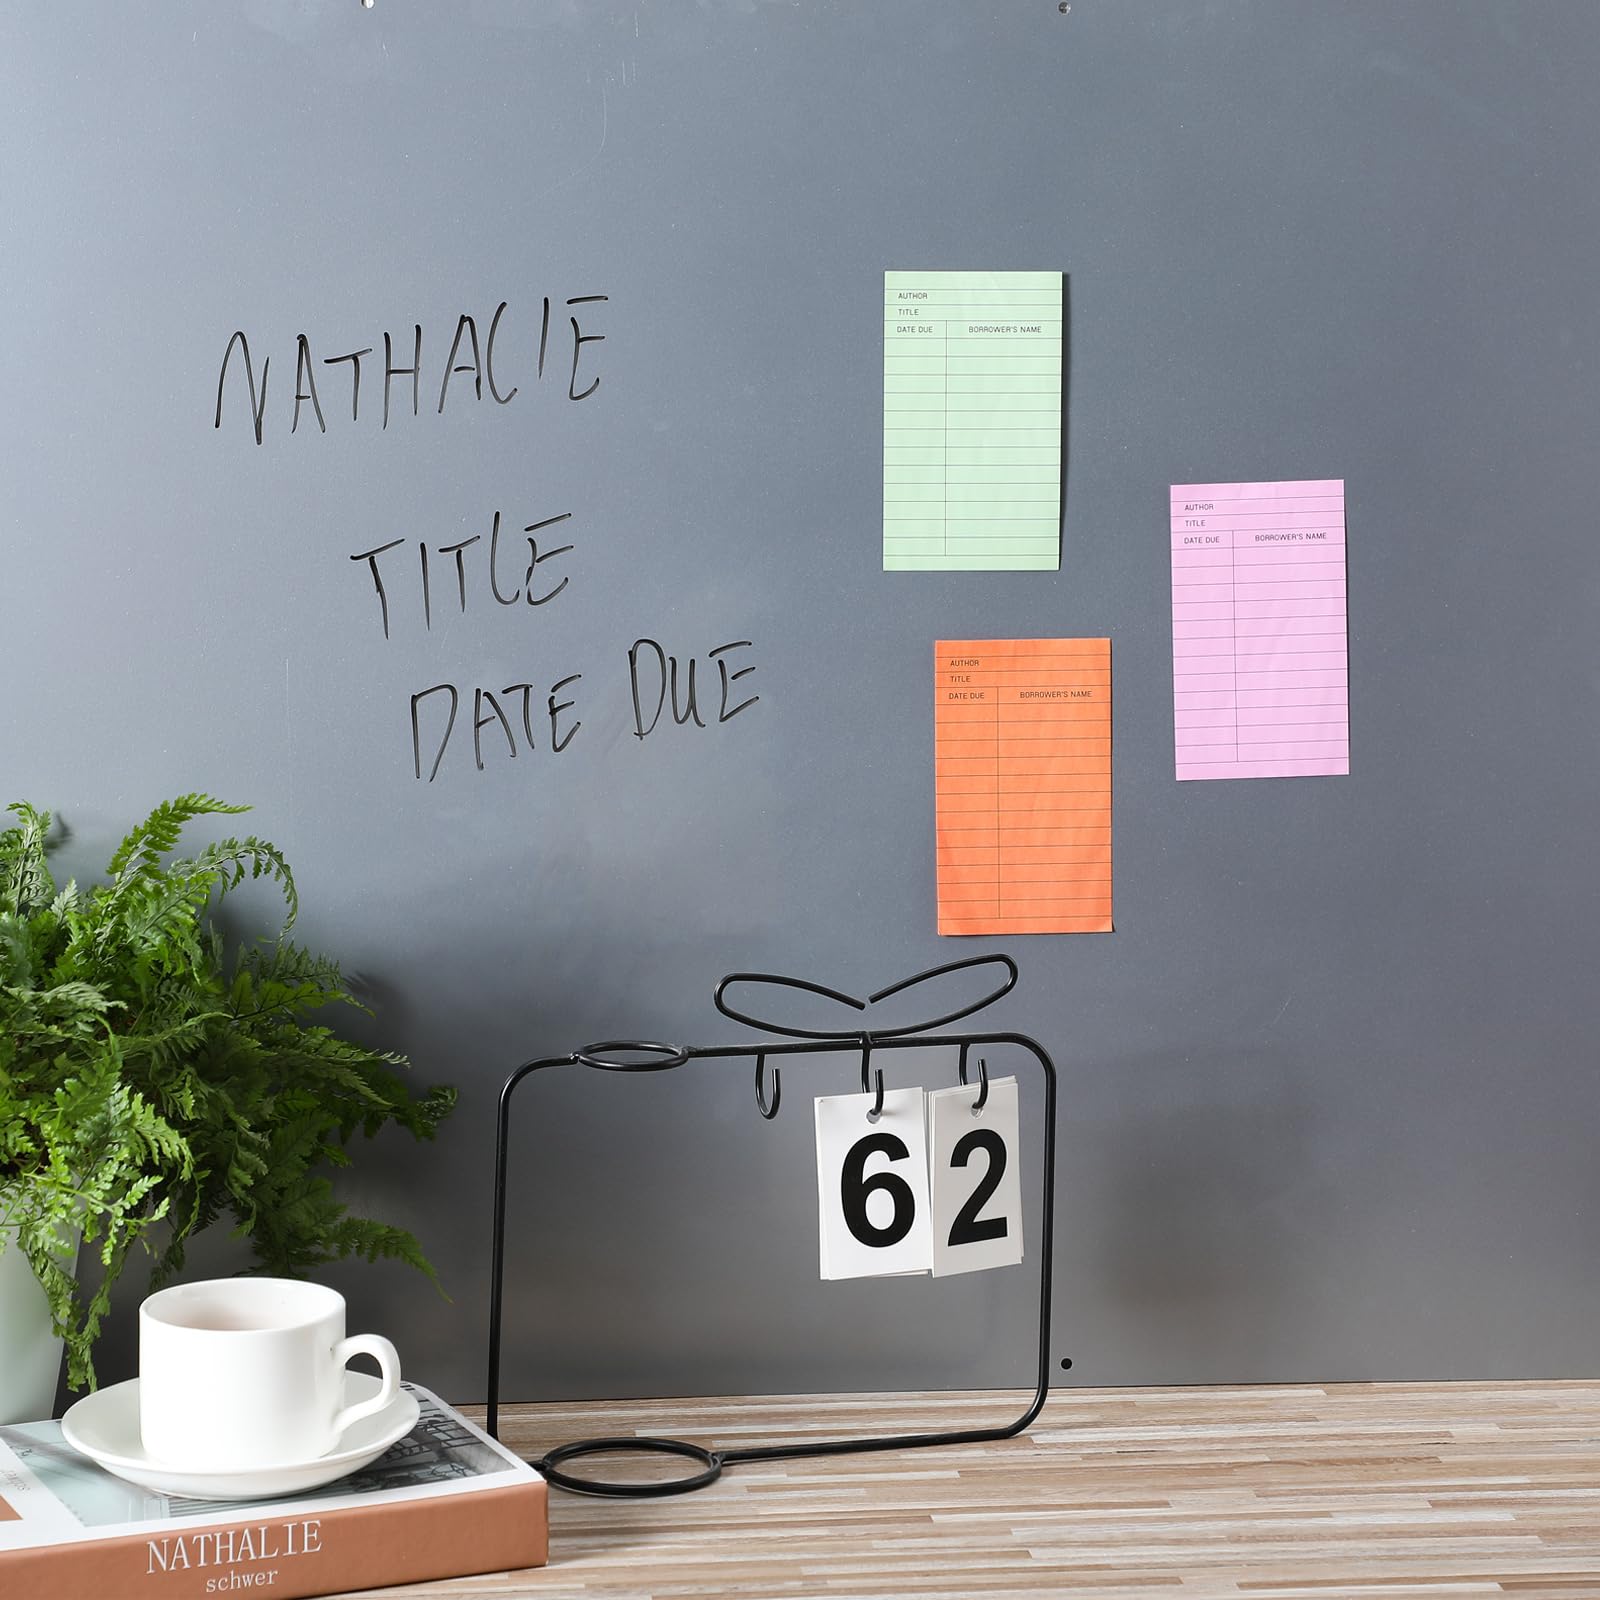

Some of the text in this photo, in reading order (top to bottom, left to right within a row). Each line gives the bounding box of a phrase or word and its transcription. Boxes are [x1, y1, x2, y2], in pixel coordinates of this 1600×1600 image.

[897, 292, 928, 300] AUTHOR
[897, 308, 920, 316] TITLE
[896, 325, 934, 334] DATE DUE
[968, 325, 1042, 334] BORROWER'S NAME
[1184, 503, 1214, 511] AUTHOR
[1184, 519, 1206, 527] TITLE
[1183, 535, 1220, 545] DATE DUE
[1254, 531, 1327, 542] BORROWER'S NAME
[349, 510, 575, 640] TITLE
[949, 659, 980, 667] AUTHOR
[949, 675, 971, 683] TITLE
[948, 692, 985, 700] DATE DUE
[1019, 690, 1092, 699] BORROWER'S NAME
[410, 638, 760, 783] DATE DUE
[145, 1519, 322, 1575] NATHALIE
[205, 1569, 279, 1593] schwer
